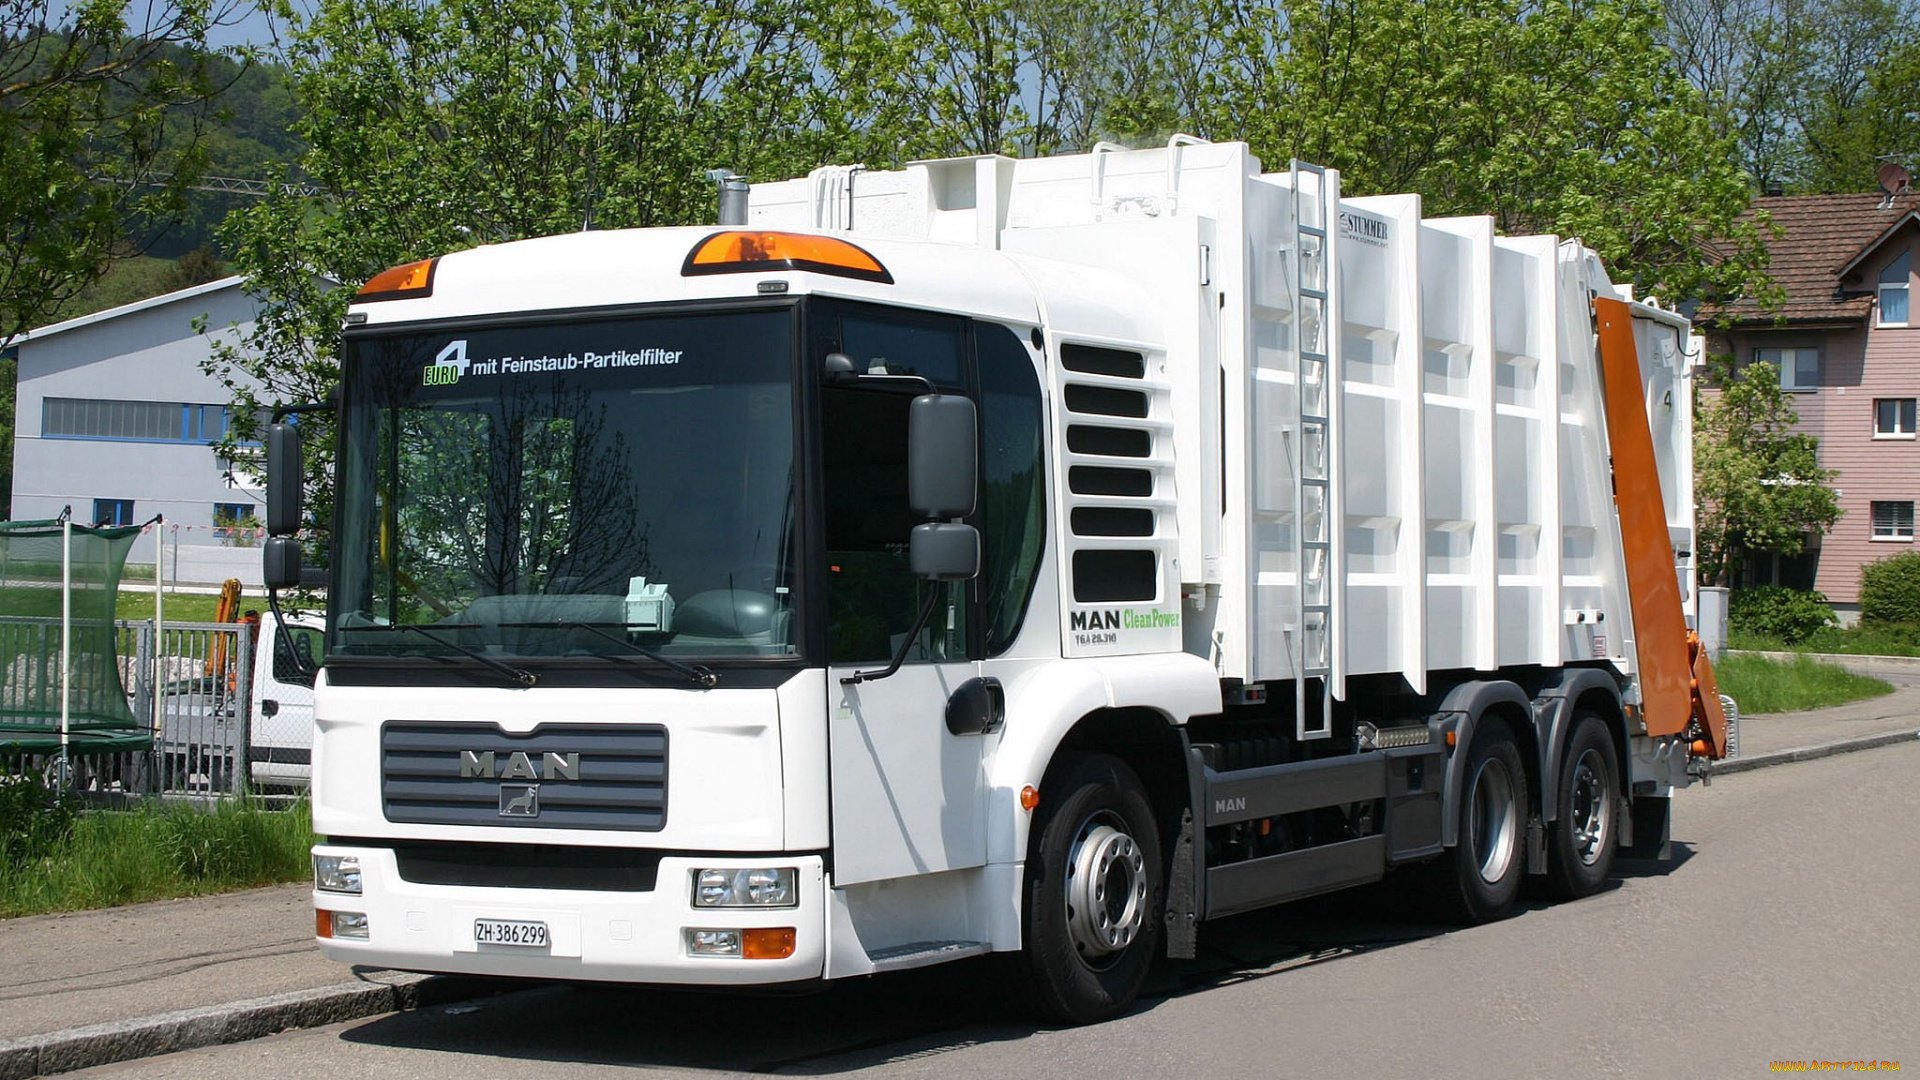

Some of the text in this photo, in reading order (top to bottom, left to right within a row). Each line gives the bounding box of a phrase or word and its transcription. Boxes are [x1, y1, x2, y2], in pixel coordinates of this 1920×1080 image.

[1347, 213, 1388, 240] STUMMER
[423, 339, 683, 386] EURO 4 mit Feinstaub-Partikelfilter
[1663, 390, 1672, 413] 4
[1070, 610, 1120, 631] MAN
[460, 749, 580, 781] MAN
[1215, 796, 1246, 813] MAN
